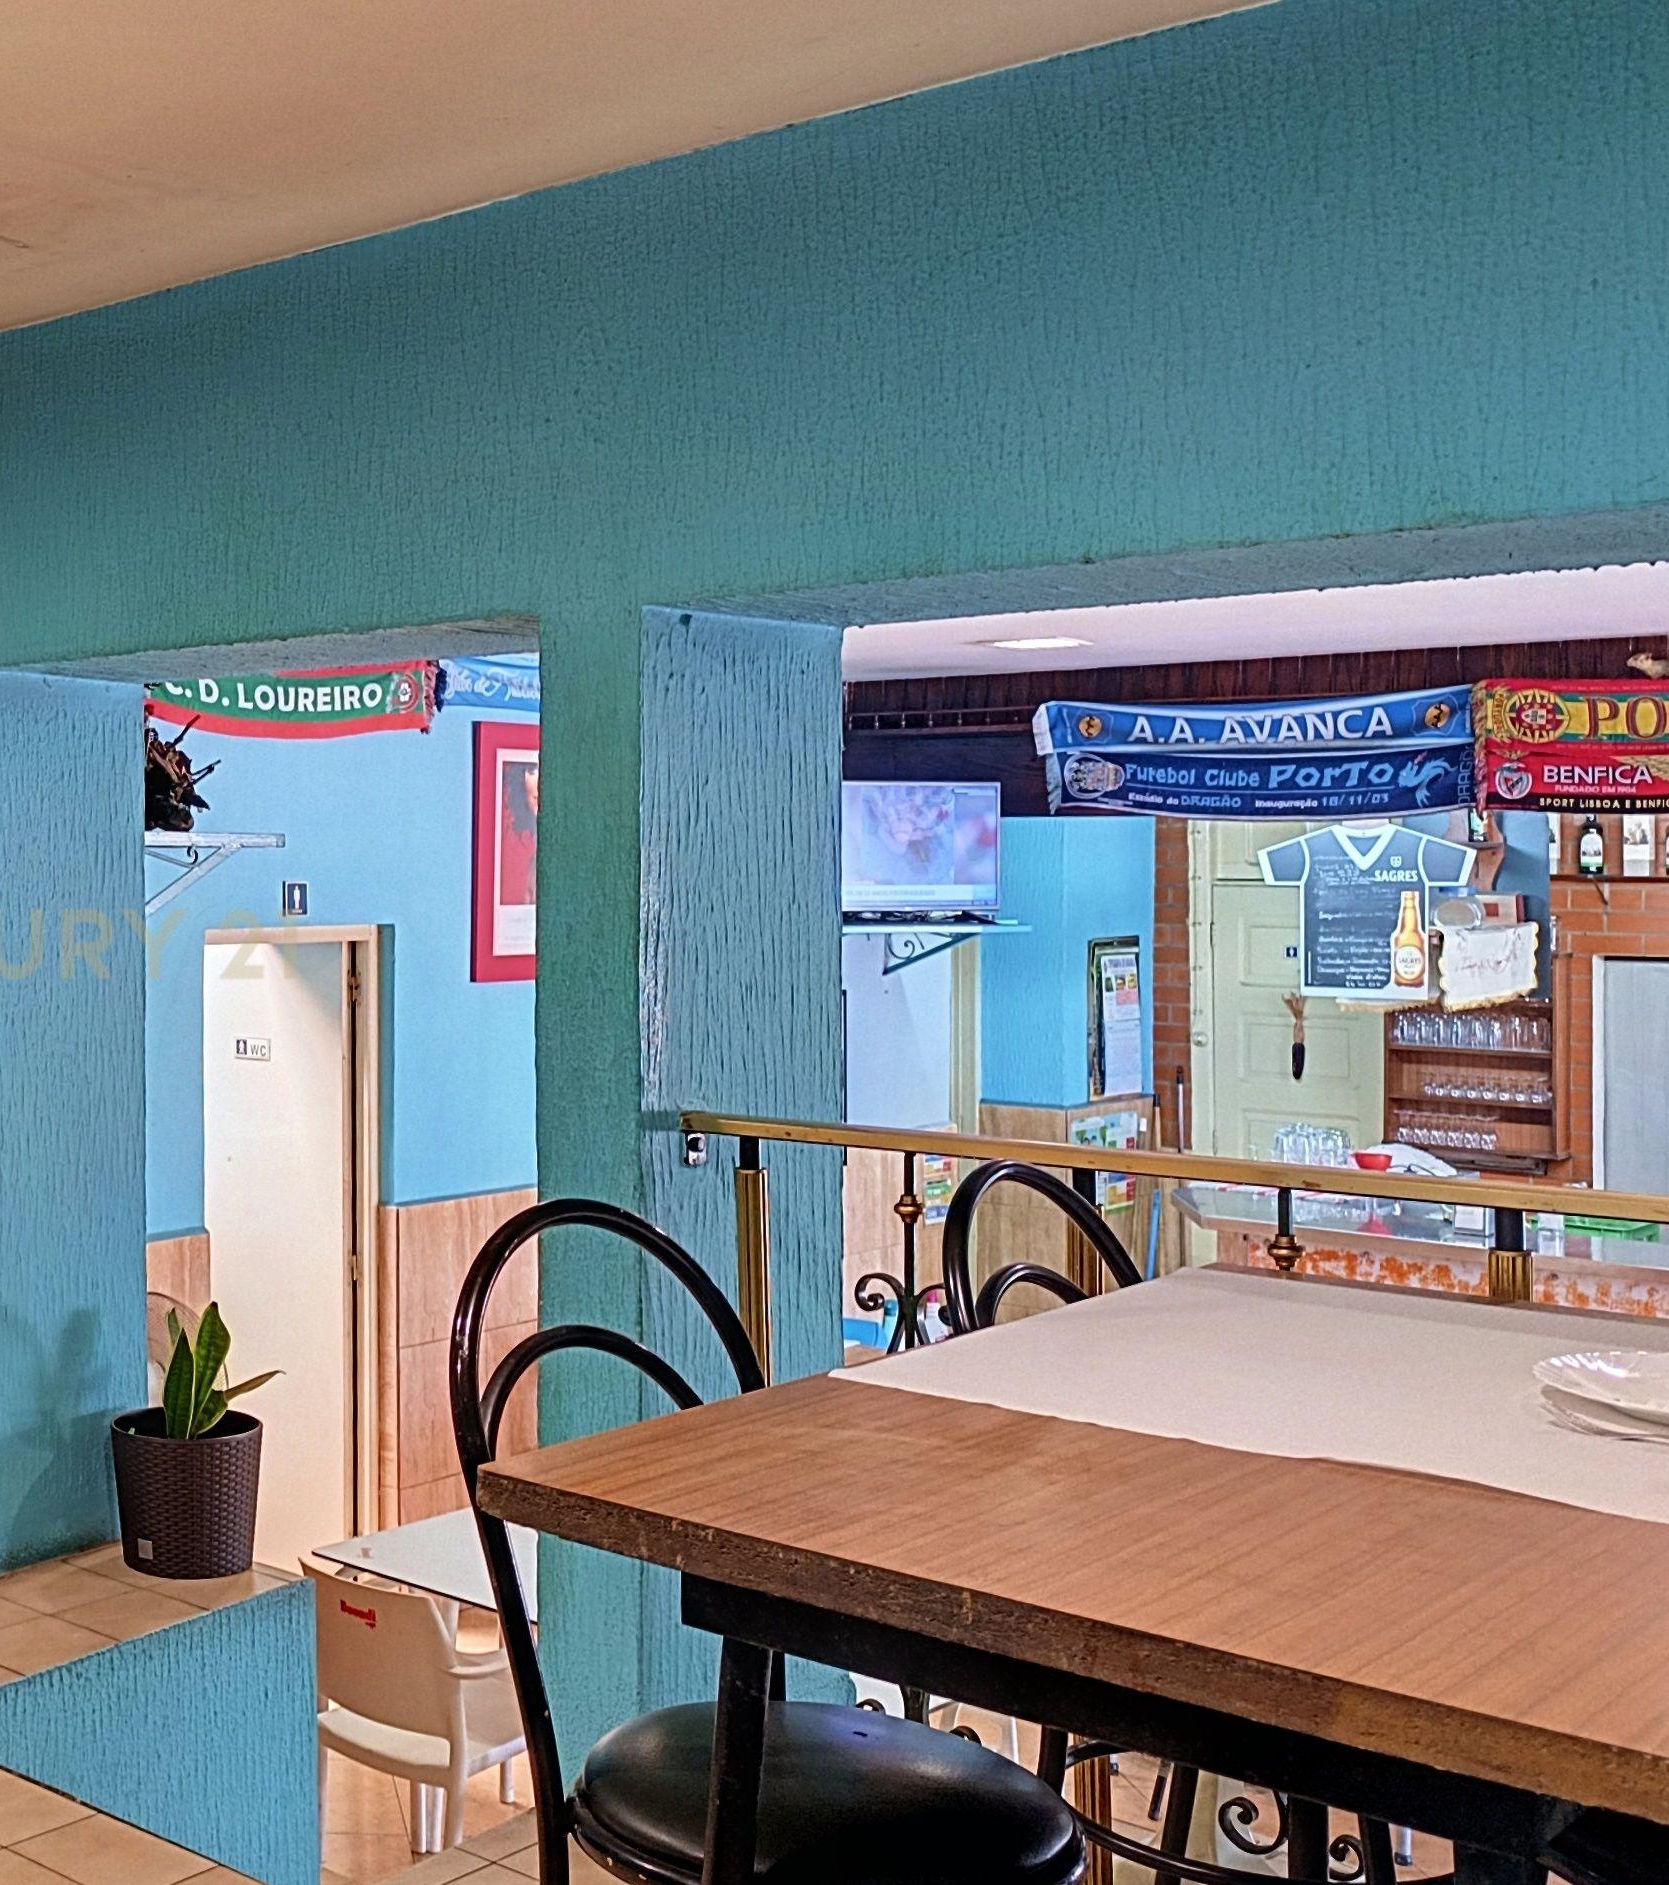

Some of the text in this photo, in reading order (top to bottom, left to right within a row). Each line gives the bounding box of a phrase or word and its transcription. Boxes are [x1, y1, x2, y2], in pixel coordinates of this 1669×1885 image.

[198, 678, 230, 707] D.
[236, 683, 383, 713] LOUREIRO
[1219, 706, 1394, 744] AVANCA
[1124, 763, 1195, 786] Futebol
[1204, 767, 1260, 788] Clube
[1543, 764, 1653, 785] BENFICA
[1554, 785, 1600, 794] FUNDADO
[1601, 785, 1615, 794] EM
[1180, 794, 1242, 808] DRAGÃO
[1539, 797, 1574, 808] SPORT
[1579, 798, 1620, 809] LISBOA
[1625, 799, 1631, 808] E
[1374, 869, 1419, 882] SAGRES
[250, 1044, 267, 1057] WC
